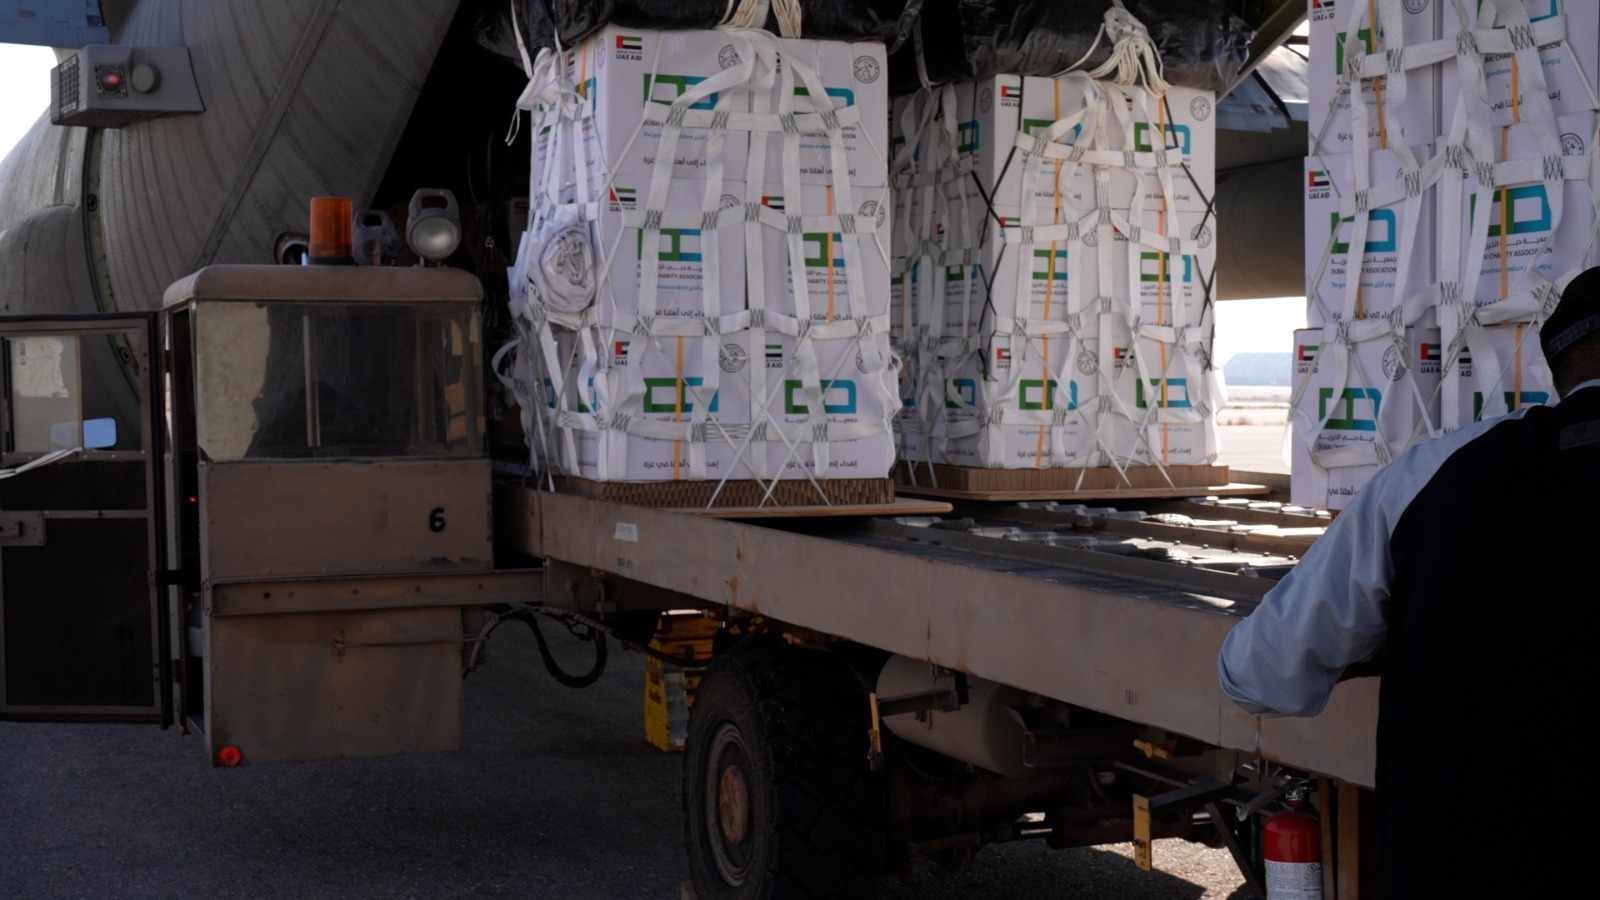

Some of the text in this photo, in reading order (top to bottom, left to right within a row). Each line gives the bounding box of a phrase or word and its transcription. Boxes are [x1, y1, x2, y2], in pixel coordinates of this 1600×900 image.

[1309, 192, 1319, 200] UAE
[1365, 266, 1397, 274] ASSOCIATION
[1420, 366, 1435, 374] UAE
[429, 507, 446, 532] 6
